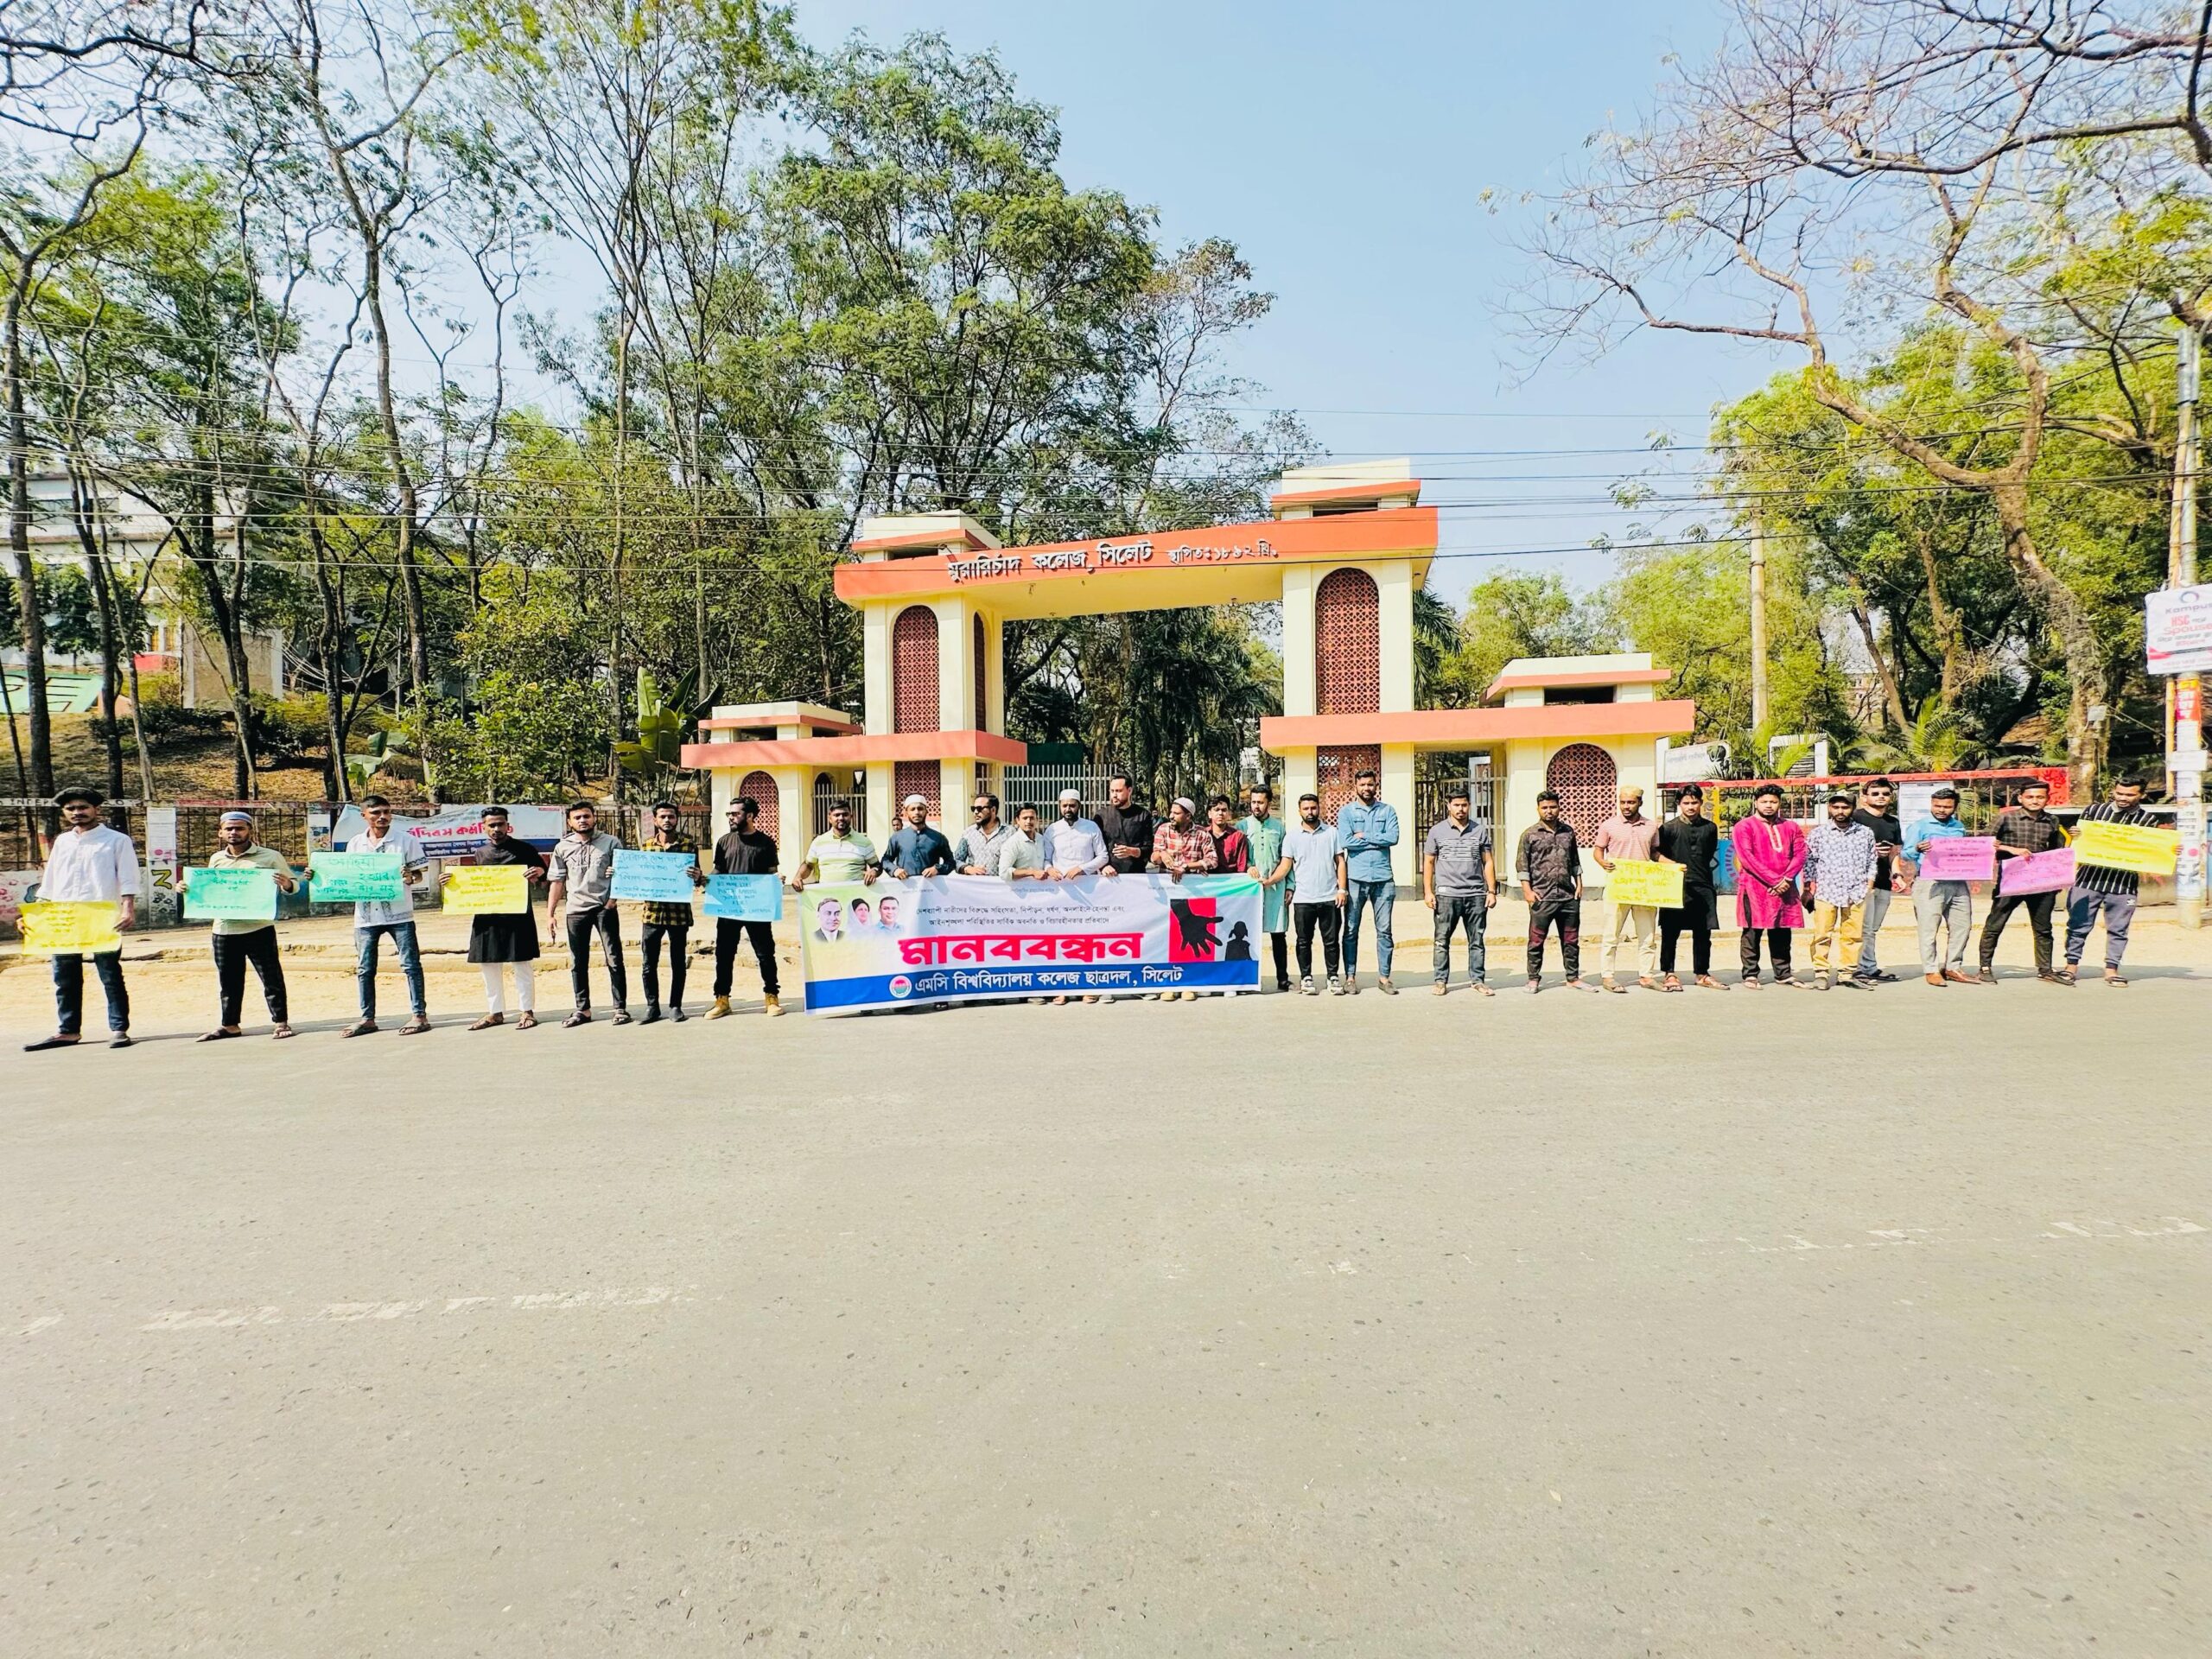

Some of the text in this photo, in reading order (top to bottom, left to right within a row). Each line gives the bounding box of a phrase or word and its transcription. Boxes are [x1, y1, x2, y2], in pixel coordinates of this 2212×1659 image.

[945, 554, 1022, 583] মুরারিচাঁদ
[1096, 540, 1154, 565] সিলেট
[2171, 614, 2190, 626] HSC
[898, 932, 1144, 965] মানববন্ধন
[915, 972, 948, 993] এমসি
[952, 969, 1033, 990] বিশ্ববিদ্যালয়
[1037, 970, 1080, 986] কলেজ
[1141, 965, 1184, 985] সিলেট
